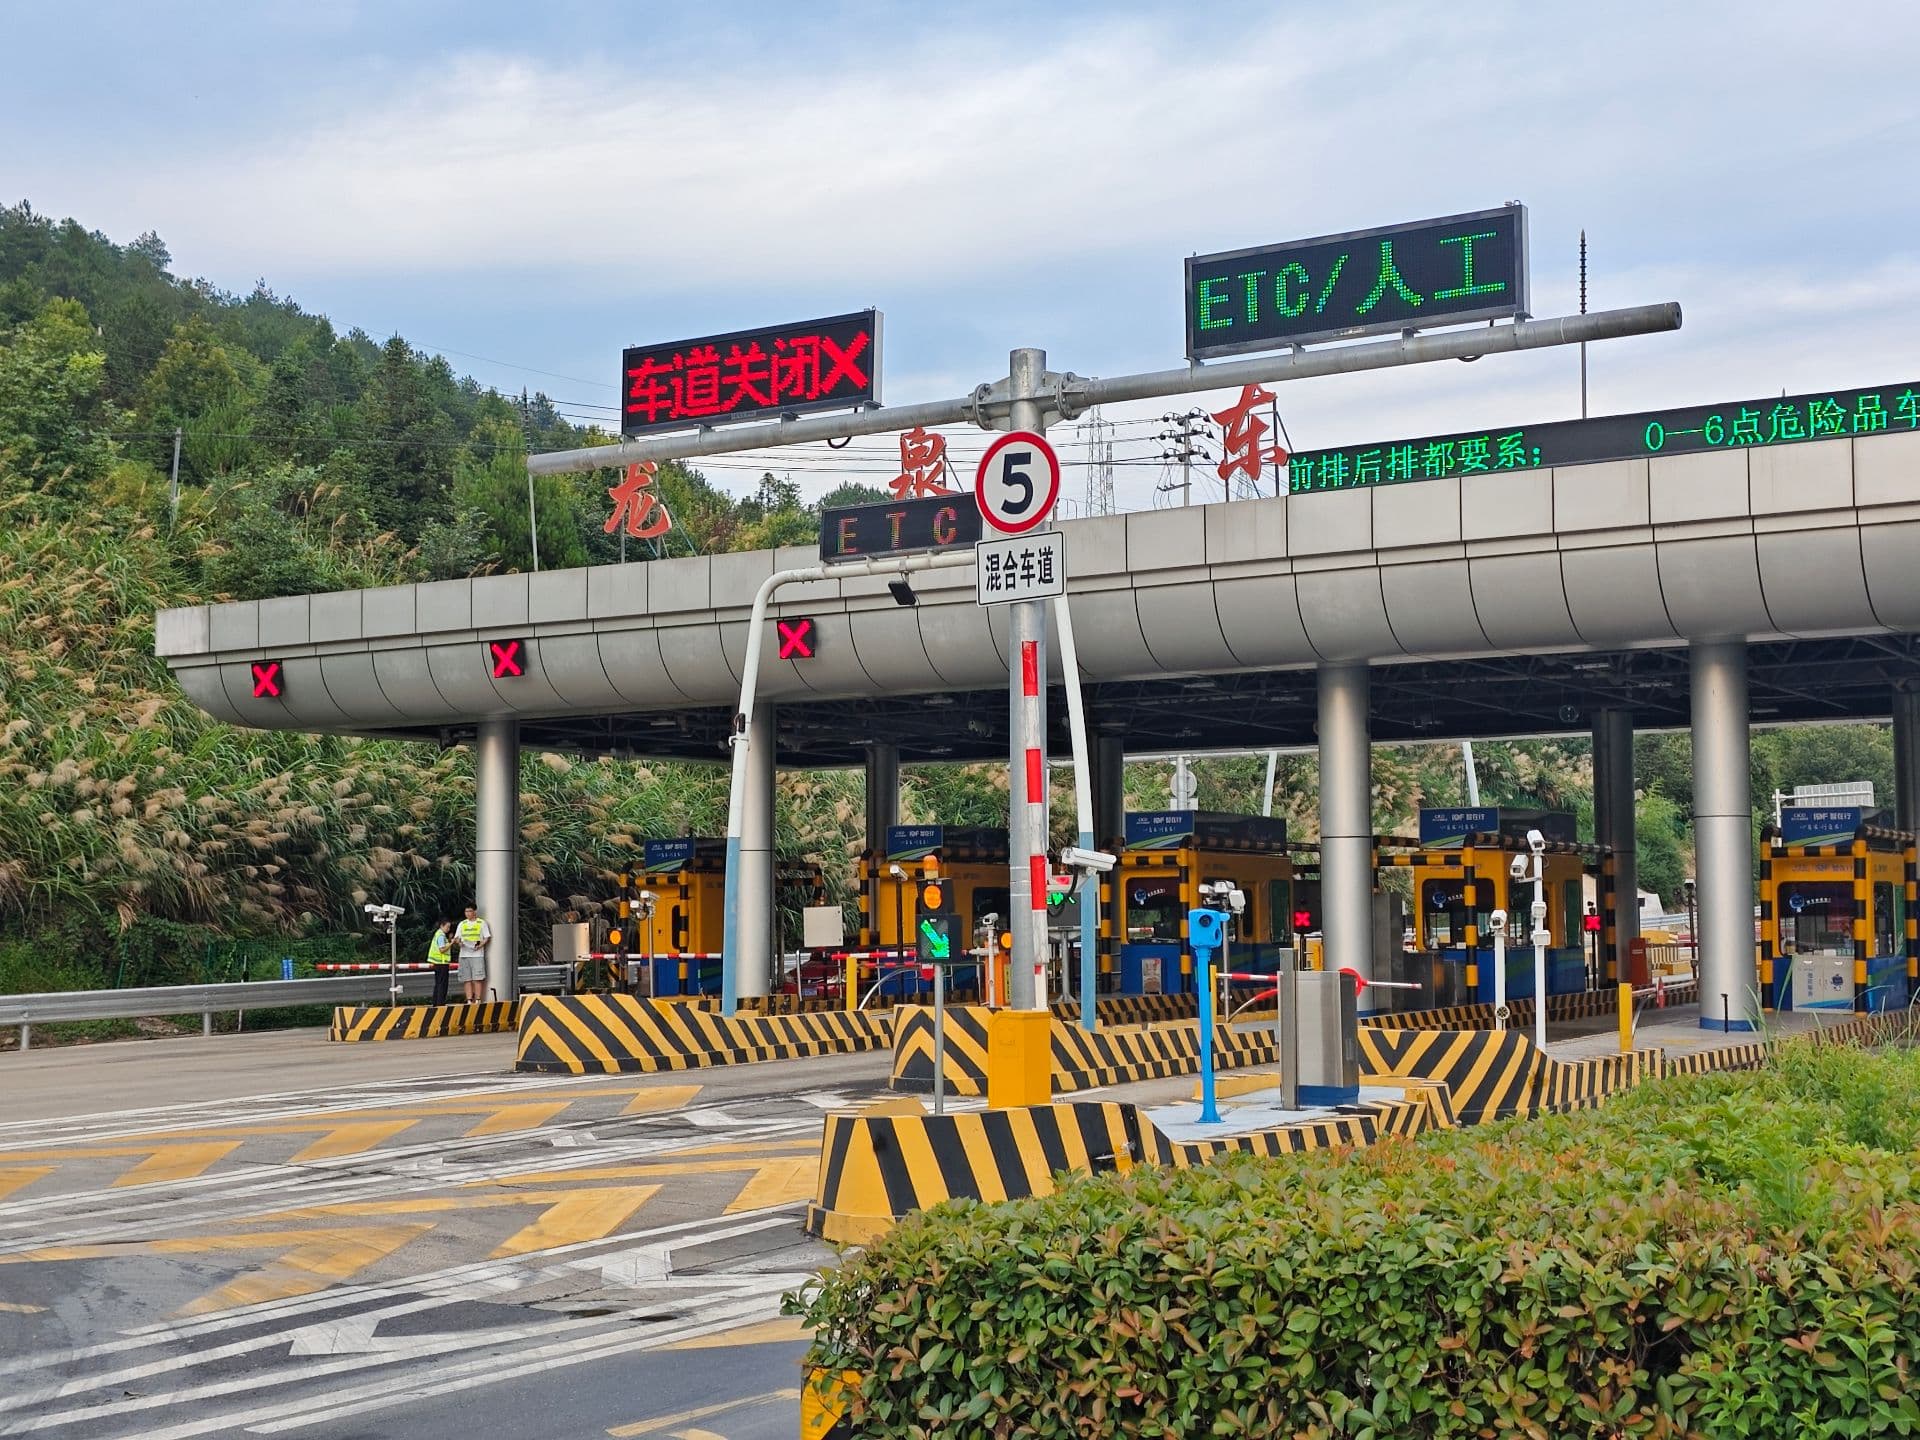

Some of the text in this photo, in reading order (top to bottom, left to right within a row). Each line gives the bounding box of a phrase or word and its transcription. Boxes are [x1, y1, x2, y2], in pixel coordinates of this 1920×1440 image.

[1199, 231, 1506, 331] ETC/人工
[627, 335, 822, 423] 车道关闭
[603, 383, 1288, 538] 龙 泉 东
[1001, 451, 1034, 515] 5
[985, 546, 1055, 592] 混合车道
